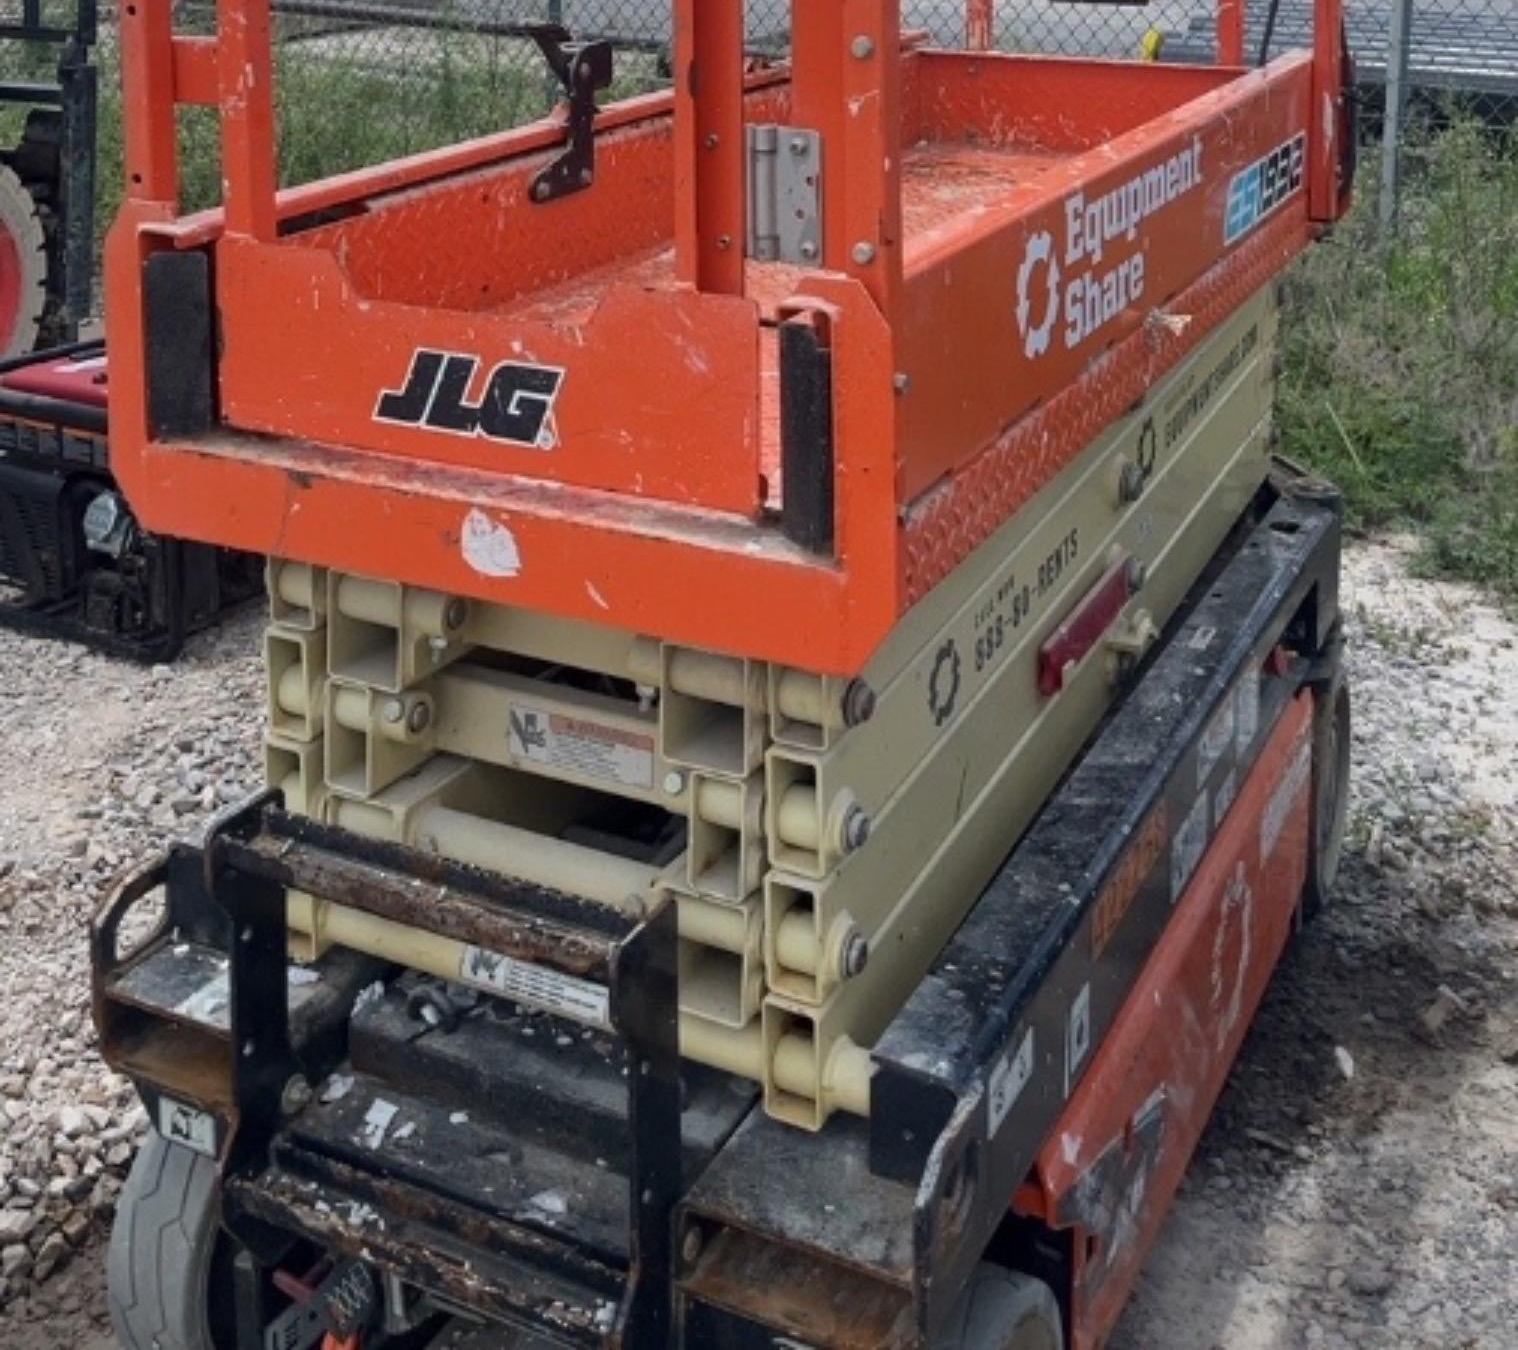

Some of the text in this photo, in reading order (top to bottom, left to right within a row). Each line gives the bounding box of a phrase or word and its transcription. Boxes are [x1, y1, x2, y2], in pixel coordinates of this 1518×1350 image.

[1064, 134, 1204, 265] Equipment
[1064, 252, 1145, 349] Share
[371, 347, 565, 447] JLG
